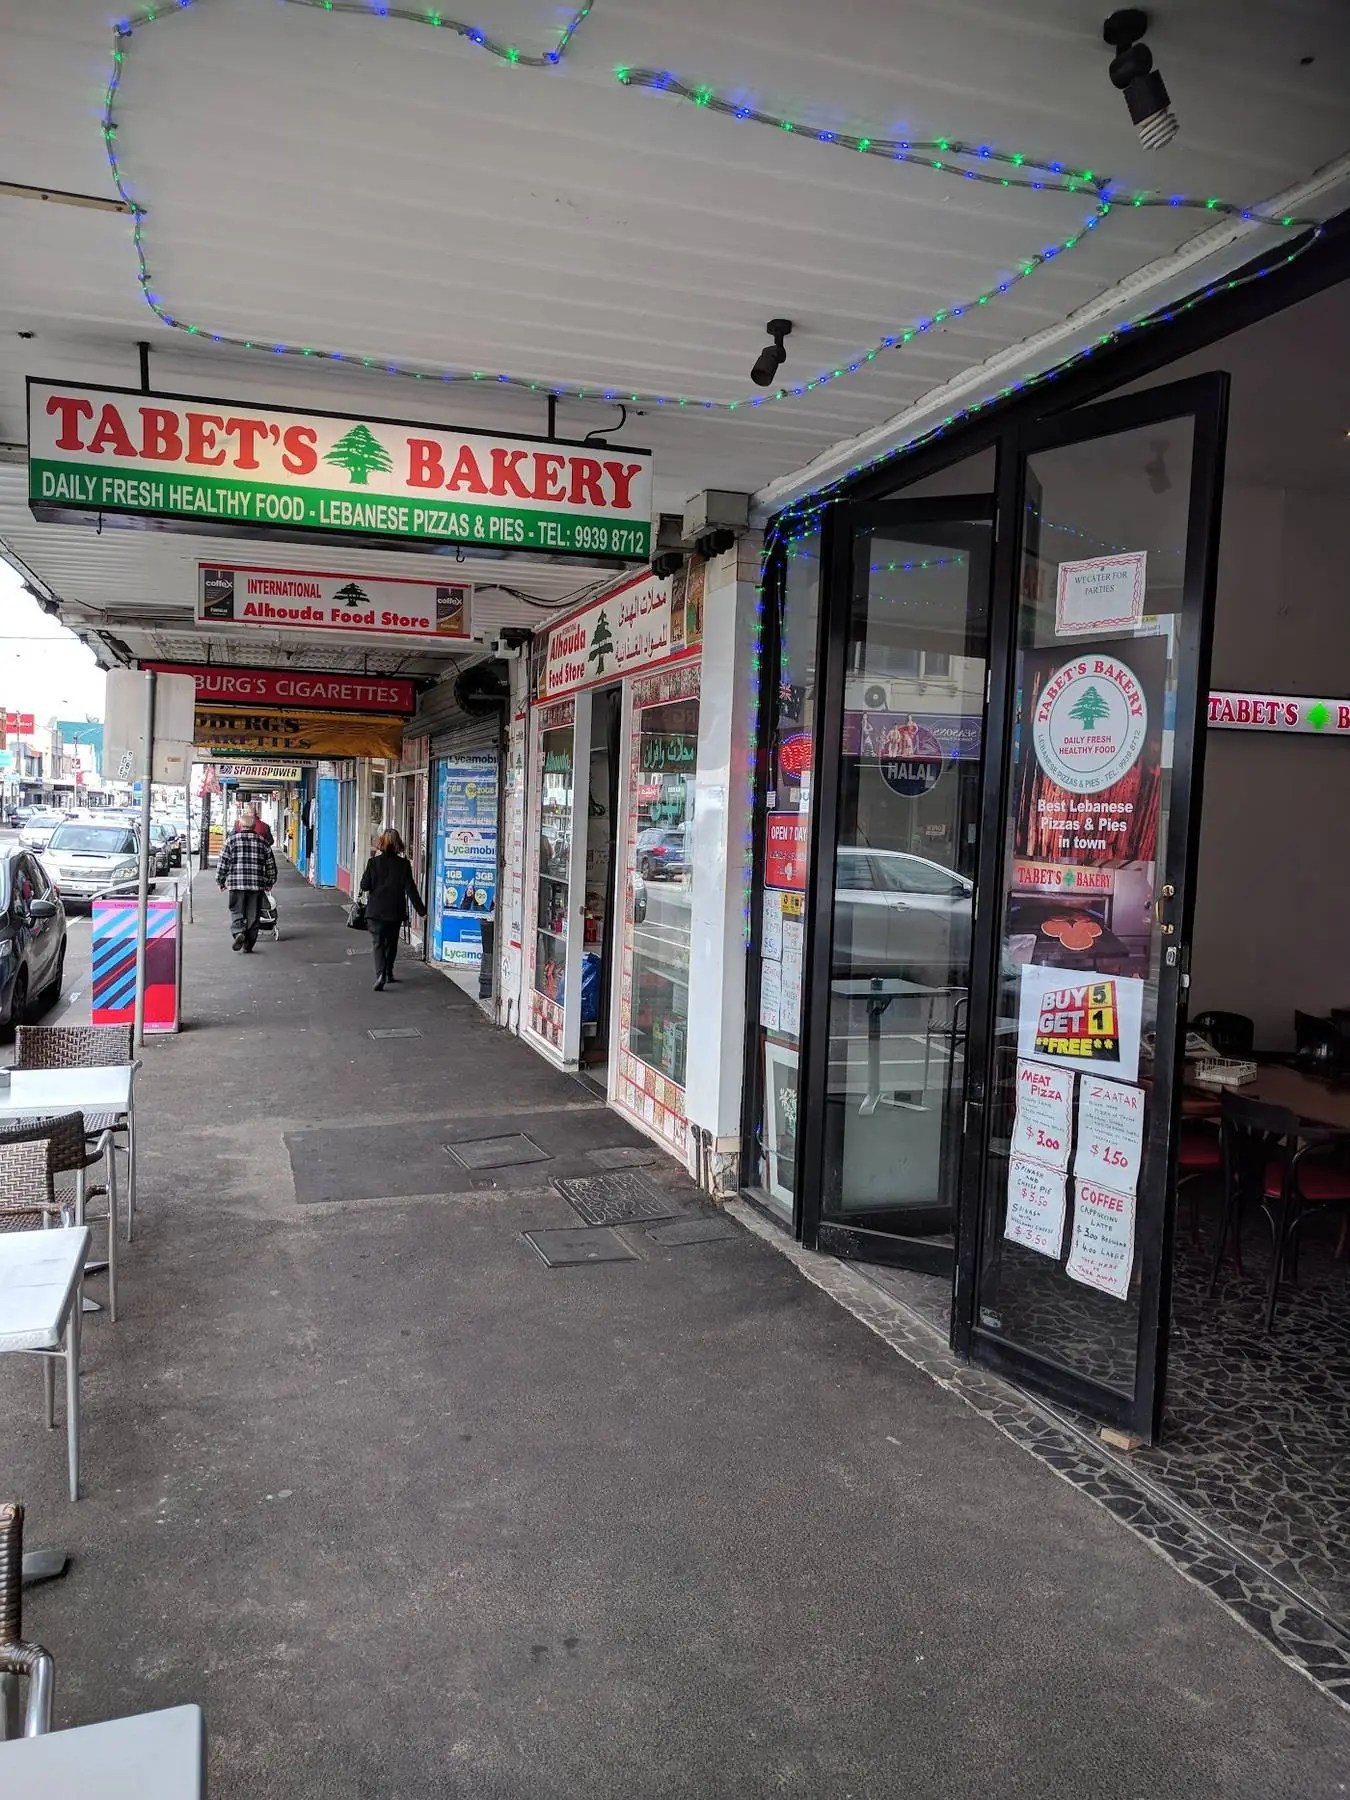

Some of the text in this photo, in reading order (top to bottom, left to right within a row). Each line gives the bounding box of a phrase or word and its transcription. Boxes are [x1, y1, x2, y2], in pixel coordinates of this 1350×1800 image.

[46, 395, 642, 508] TABET'S BAKERY
[42, 471, 97, 500] DAILY
[102, 477, 164, 507] FRESH
[169, 485, 251, 516] HEALTHY
[256, 493, 304, 521] FOOD
[320, 499, 408, 531] LEBANESE
[413, 509, 469, 537] PIZZAS
[475, 515, 485, 538] &
[489, 517, 524, 542] PIES
[538, 521, 570, 547] TEL:
[575, 525, 608, 550] 9939
[611, 529, 644, 554] 8712
[1112, 570, 1128, 581] FOR
[248, 579, 322, 598] INTERNATIONAL
[1084, 584, 1115, 595] PARTIES
[244, 602, 323, 622] Alhouda
[331, 608, 375, 625] Food
[381, 612, 430, 628] Store
[550, 624, 586, 661] Alhouda
[549, 662, 585, 688] Food Store
[275, 680, 399, 703] CIGARETTES
[1038, 660, 1142, 722] TABET'S BAKERY
[1208, 697, 1298, 727] TABET'S
[1064, 735, 1112, 744] DAILY FRESH
[1059, 745, 1116, 755] HEALTHY FOOD
[233, 764, 298, 778] SPORTSPOWER
[886, 762, 935, 780] HALAL
[1057, 771, 1078, 788] PIZZAS
[1085, 777, 1100, 788] PIES
[1037, 799, 1133, 813] Best Lebanese
[770, 825, 809, 841] OPEN 7 DAY
[1040, 817, 1127, 832] Pizzas & Pies
[1058, 835, 1106, 850] in town
[476, 872, 494, 881] 3GB
[1017, 867, 1111, 889] TABET'S BAKERY
[1042, 985, 1106, 1011] BUY 5
[1040, 1010, 1103, 1034] GET 1
[1021, 1069, 1052, 1086] MEAT
[1030, 1085, 1063, 1102] PIZZA
[1090, 1087, 1138, 1109] ZAATAR
[1026, 1124, 1034, 1140] $
[1036, 1129, 1060, 1150] 3.00
[1090, 1144, 1099, 1157] $
[1026, 1175, 1039, 1184] AND
[1021, 1187, 1048, 1207] $ 3.50
[1039, 1185, 1053, 1195] PIE
[1080, 1186, 1124, 1213] COFFEE
[1076, 1224, 1082, 1235] $
[1090, 1218, 1113, 1231] LATTE
[1014, 1225, 1047, 1246] $ 3.50
[1101, 1247, 1126, 1260] LARGE
